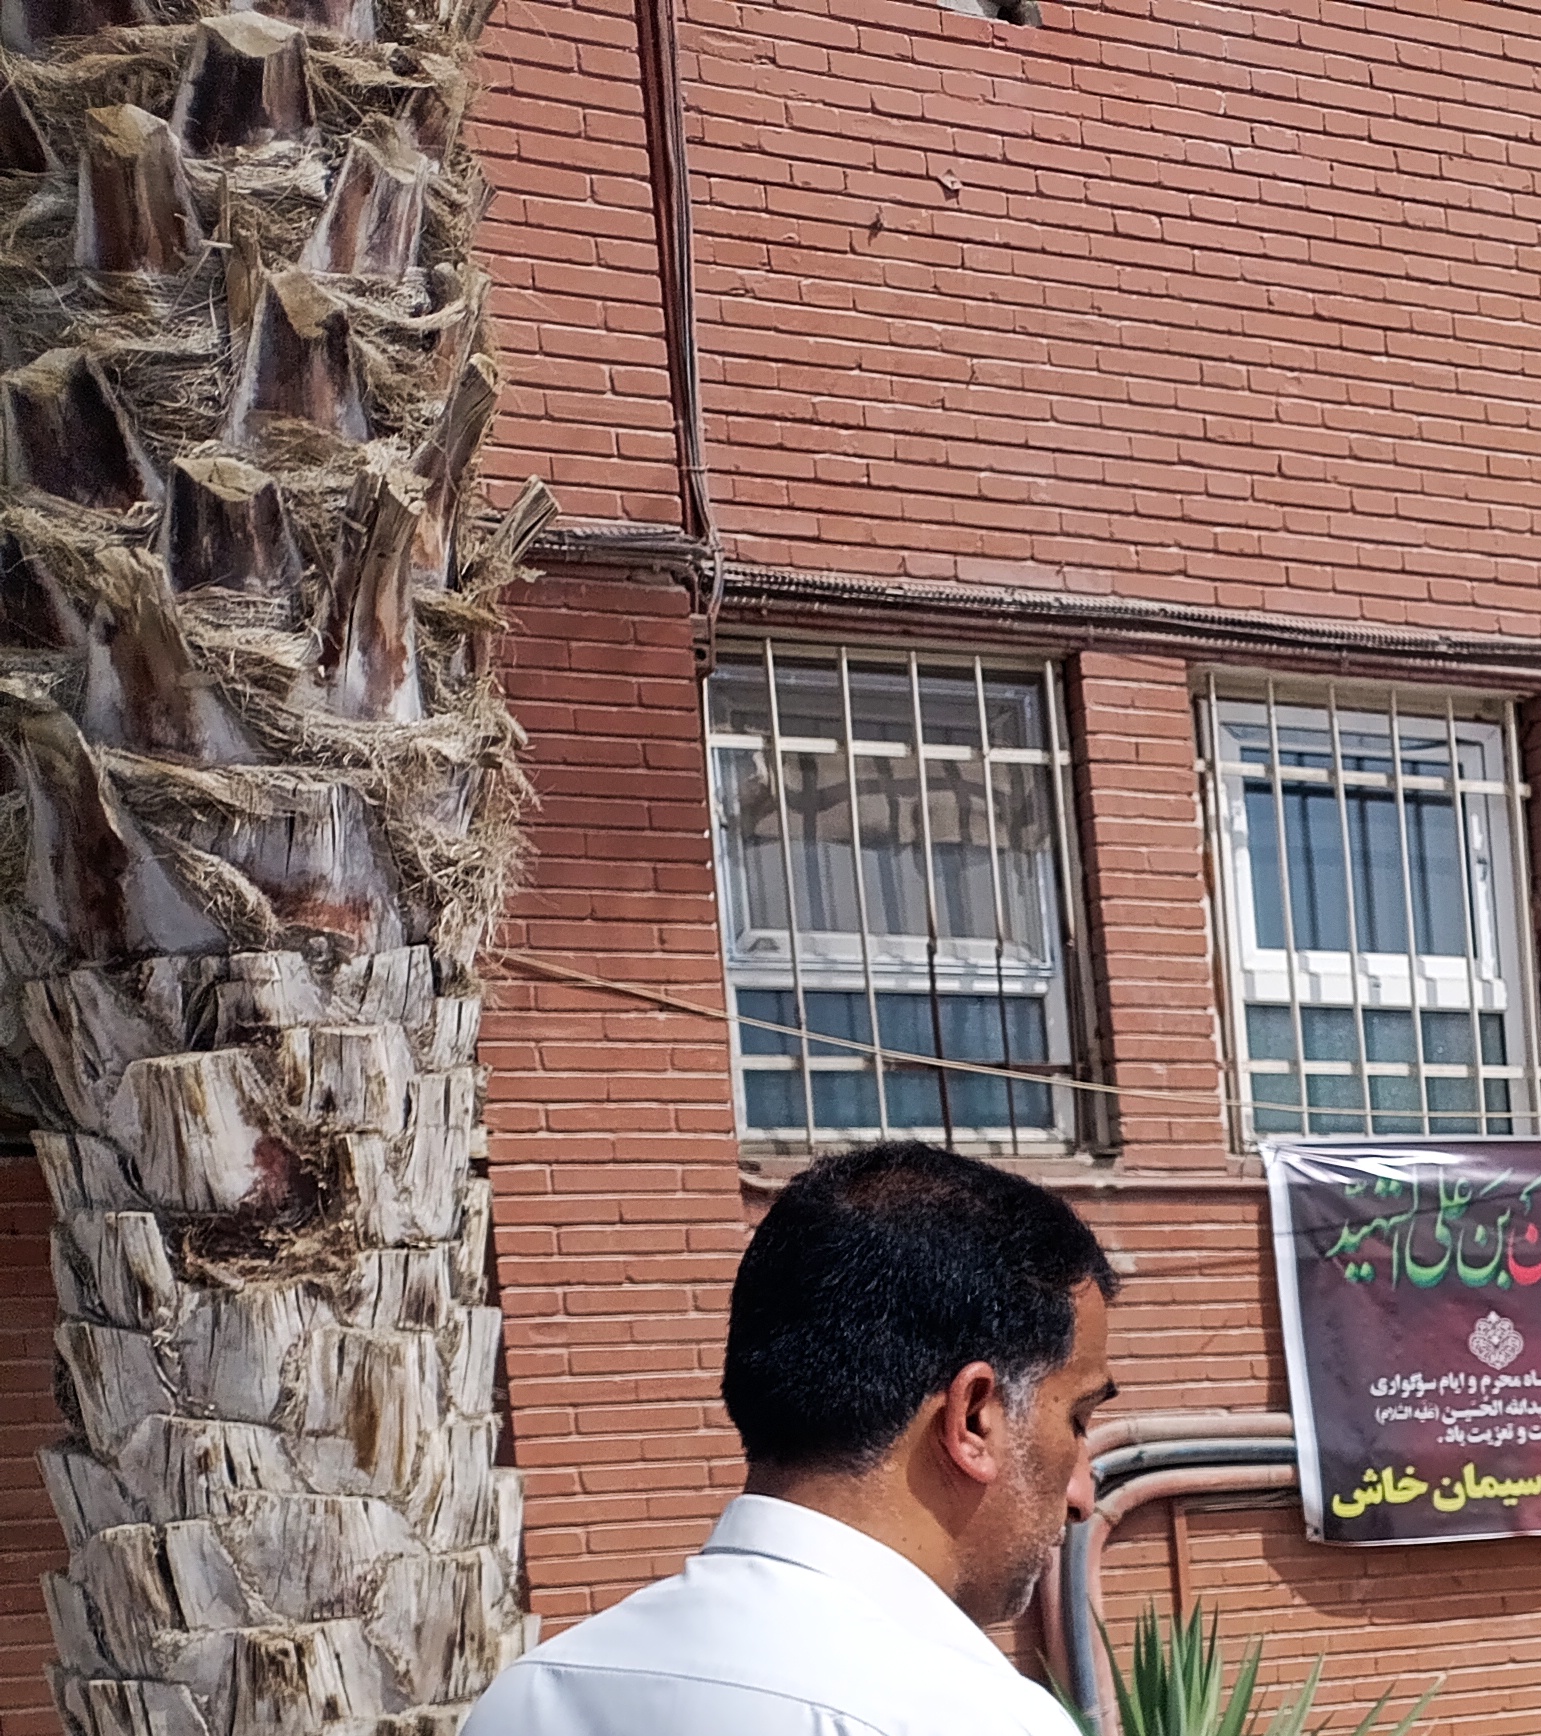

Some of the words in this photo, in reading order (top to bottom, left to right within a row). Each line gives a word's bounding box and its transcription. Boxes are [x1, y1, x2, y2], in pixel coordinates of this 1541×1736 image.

[1370, 1371, 1436, 1398] سوگواری
[1439, 1371, 1465, 1396] ایام
[1467, 1375, 1477, 1394] و
[1480, 1371, 1522, 1394] محرم
[1466, 1423, 1514, 1446] تعزیت
[1517, 1425, 1526, 1444] و
[1332, 1465, 1429, 1518] خاش
